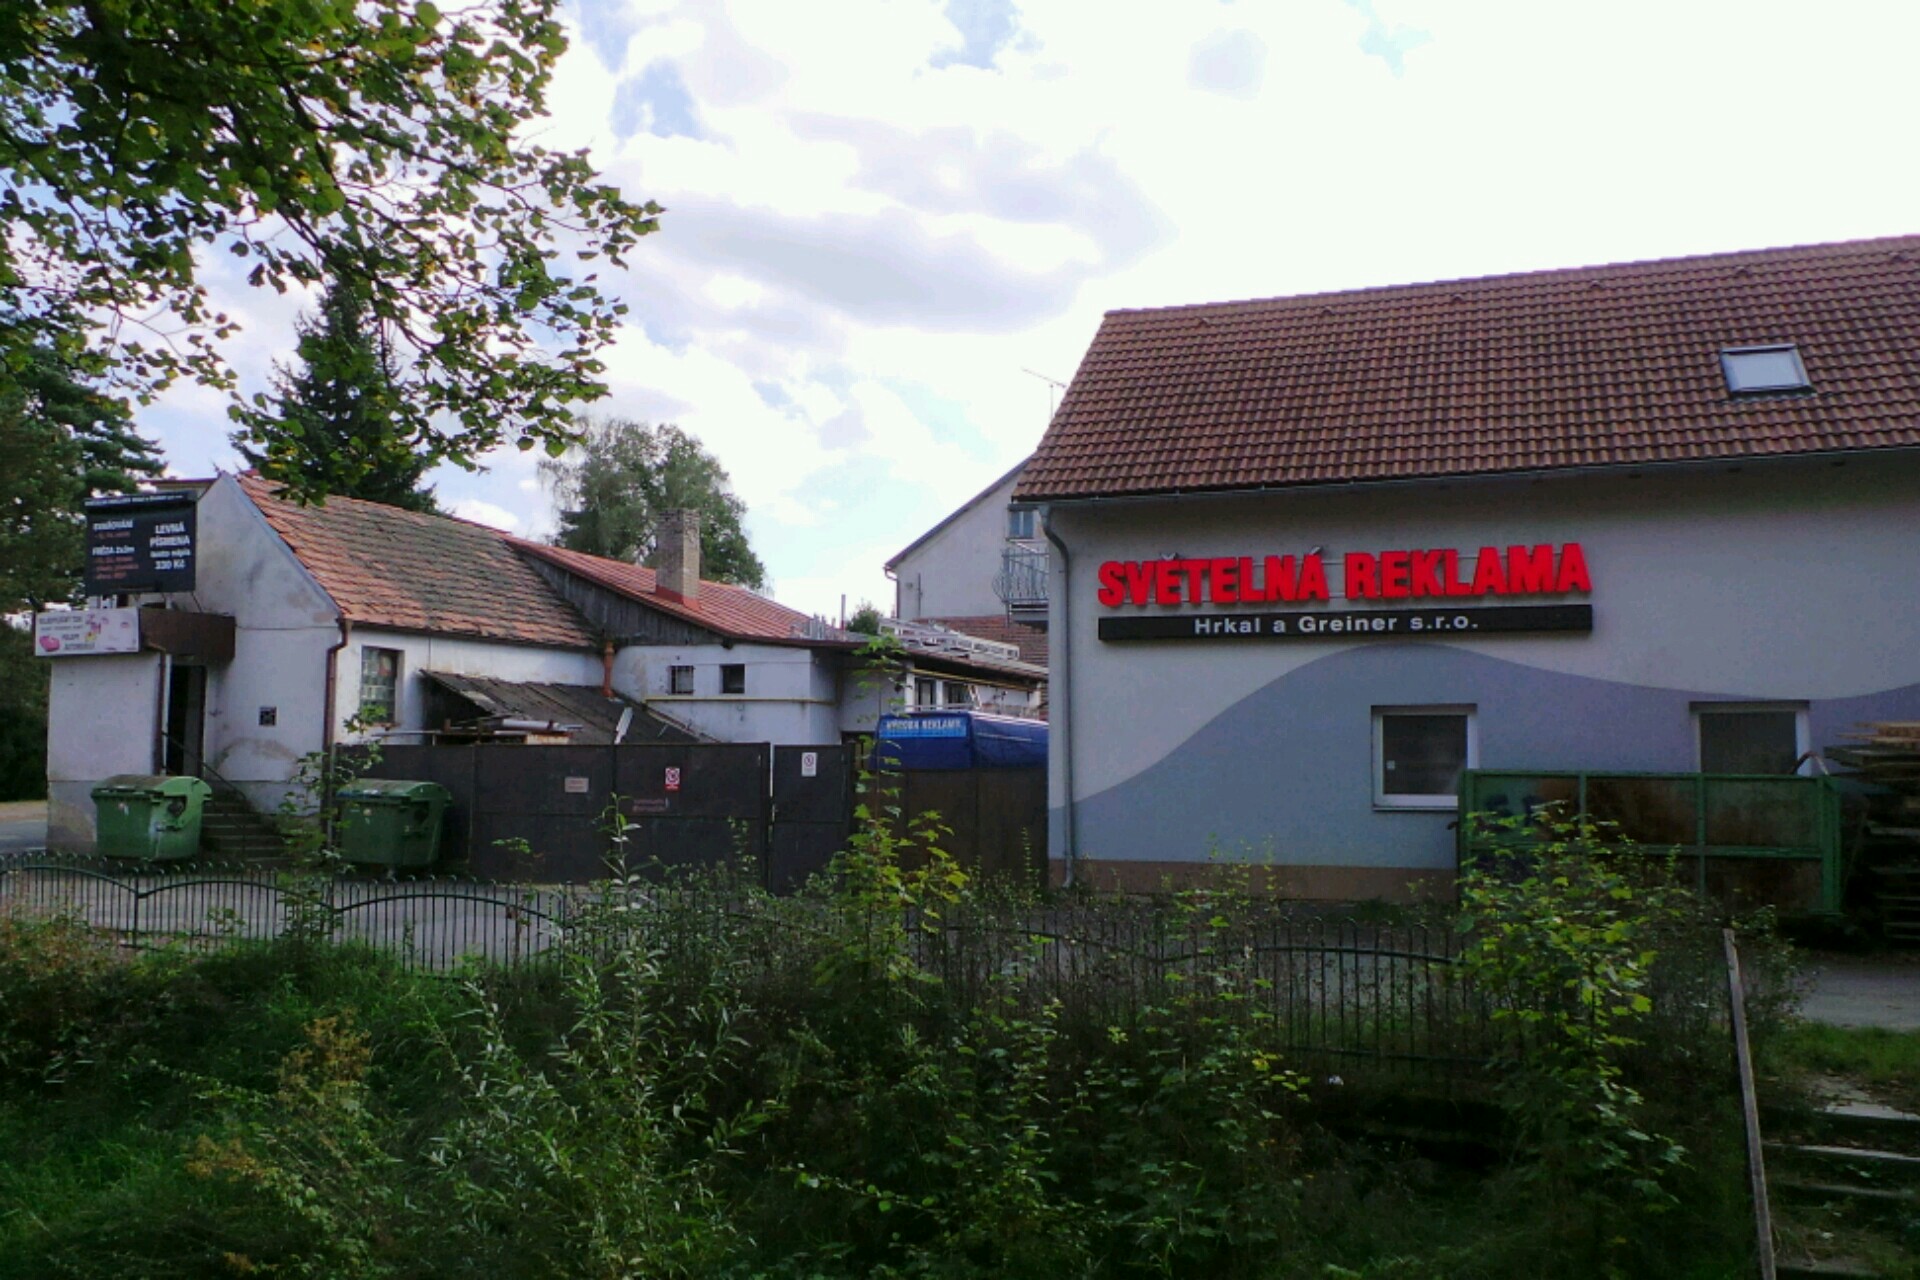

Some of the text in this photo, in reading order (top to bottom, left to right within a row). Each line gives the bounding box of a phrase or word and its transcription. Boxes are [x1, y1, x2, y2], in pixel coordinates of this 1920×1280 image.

[1098, 543, 1592, 606] SVĚTELNÁ REKLAMA
[1194, 615, 1478, 633] Hrkal a Greiner s.r.o.
